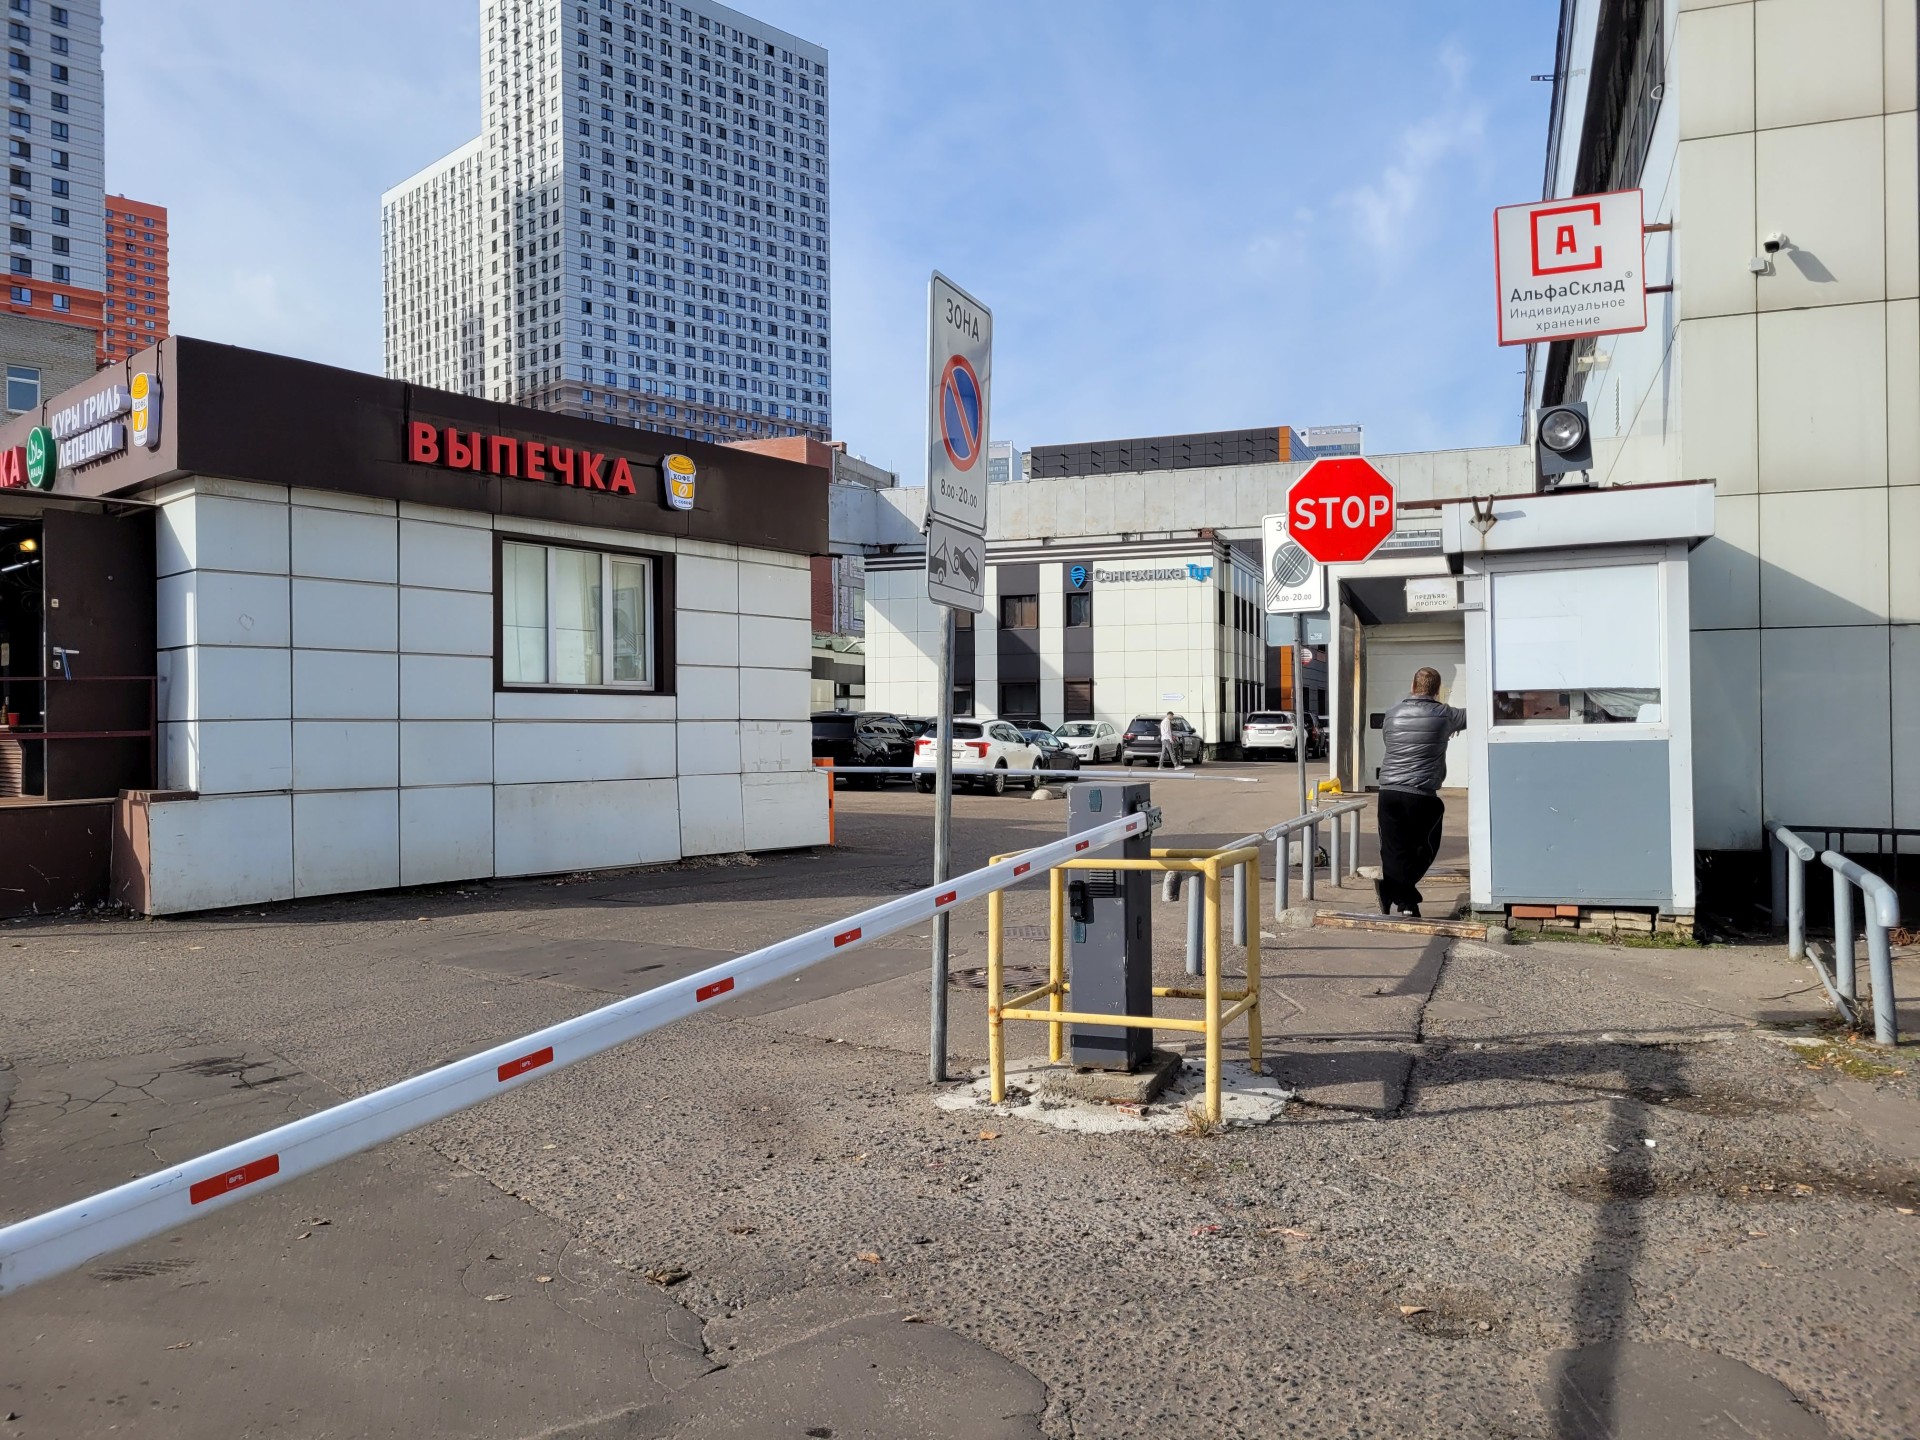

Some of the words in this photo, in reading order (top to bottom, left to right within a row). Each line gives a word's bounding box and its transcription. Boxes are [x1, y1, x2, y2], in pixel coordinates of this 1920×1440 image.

[1510, 279, 1625, 303] АльфаСклад
[946, 298, 980, 342] ЗОНА
[1510, 298, 1625, 320] Индивидуальное
[1536, 315, 1600, 333] хранение
[52, 403, 80, 440] КУРЫ
[83, 385, 121, 424] ГРИЛЬ
[59, 422, 113, 469] ЛЕПЕШКИ
[409, 421, 636, 494] ВЫПЕЧКА
[673, 473, 691, 482] КОФЕ
[1294, 495, 1390, 530] STOP
[1093, 567, 1184, 583] Сантехника
